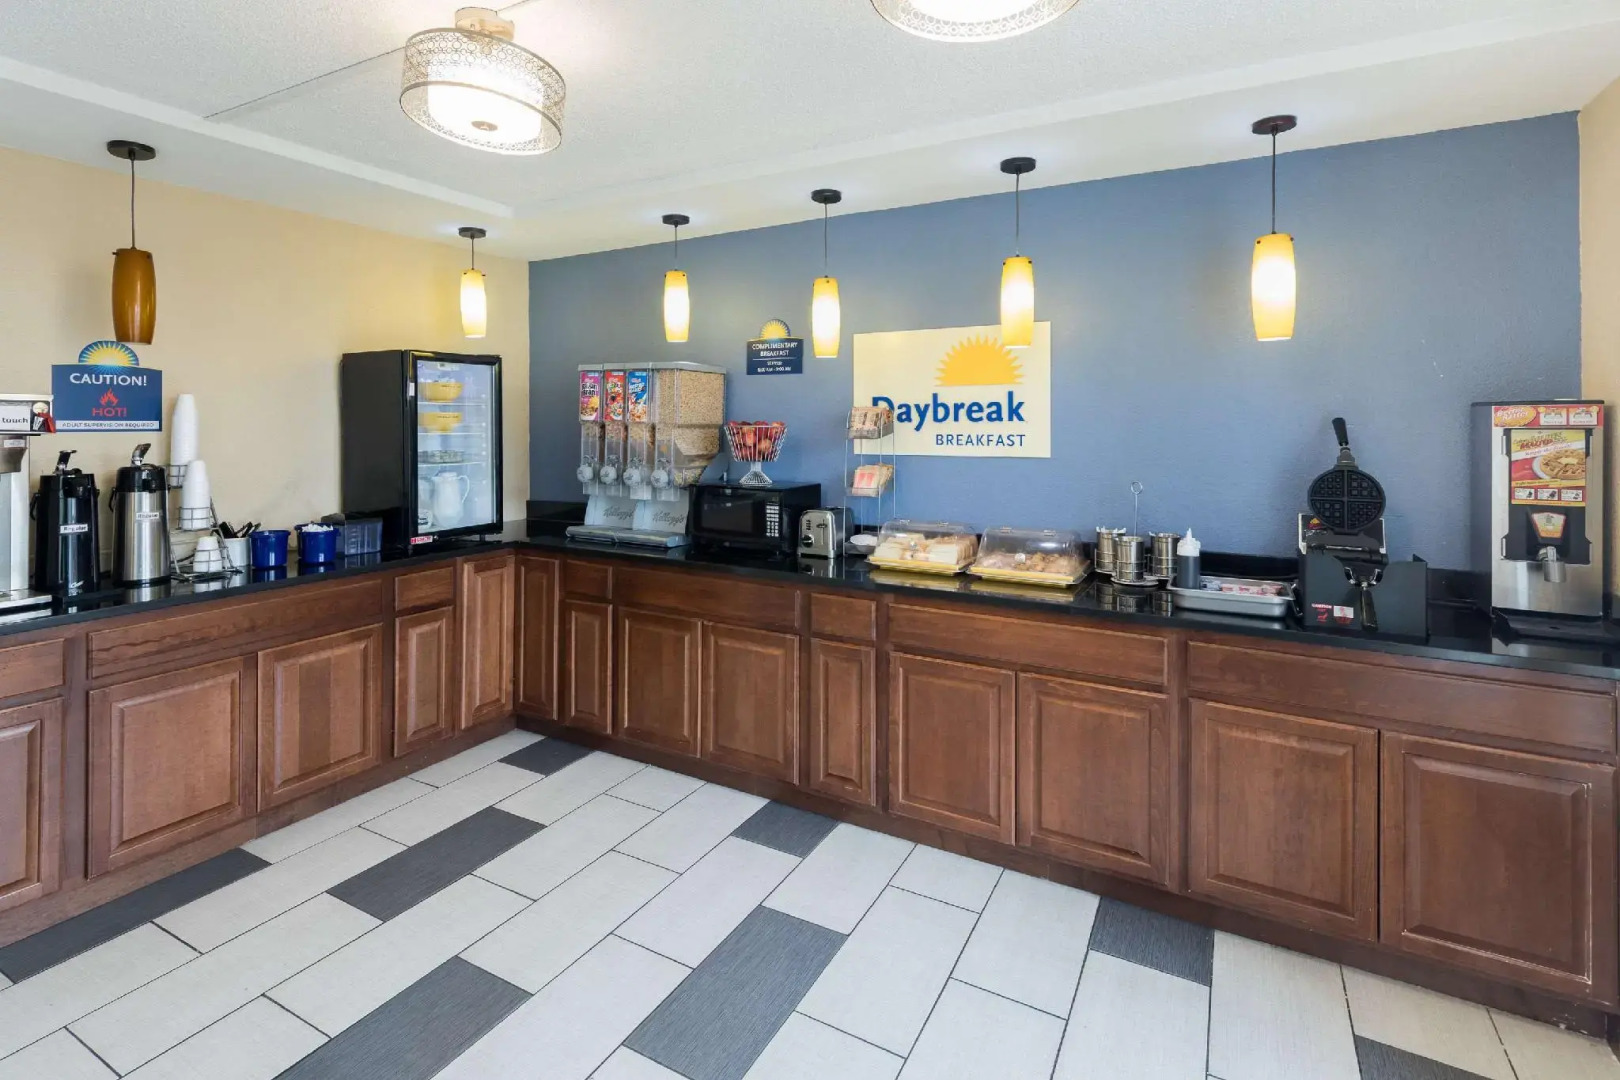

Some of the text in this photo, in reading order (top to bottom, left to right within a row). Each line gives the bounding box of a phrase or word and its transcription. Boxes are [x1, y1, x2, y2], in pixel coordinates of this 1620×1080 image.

[752, 342, 798, 350] COMPLIMENTARY
[69, 373, 147, 386] CAUTION!
[91, 407, 127, 417] HOT!
[936, 434, 1025, 447] BREAKFAST
